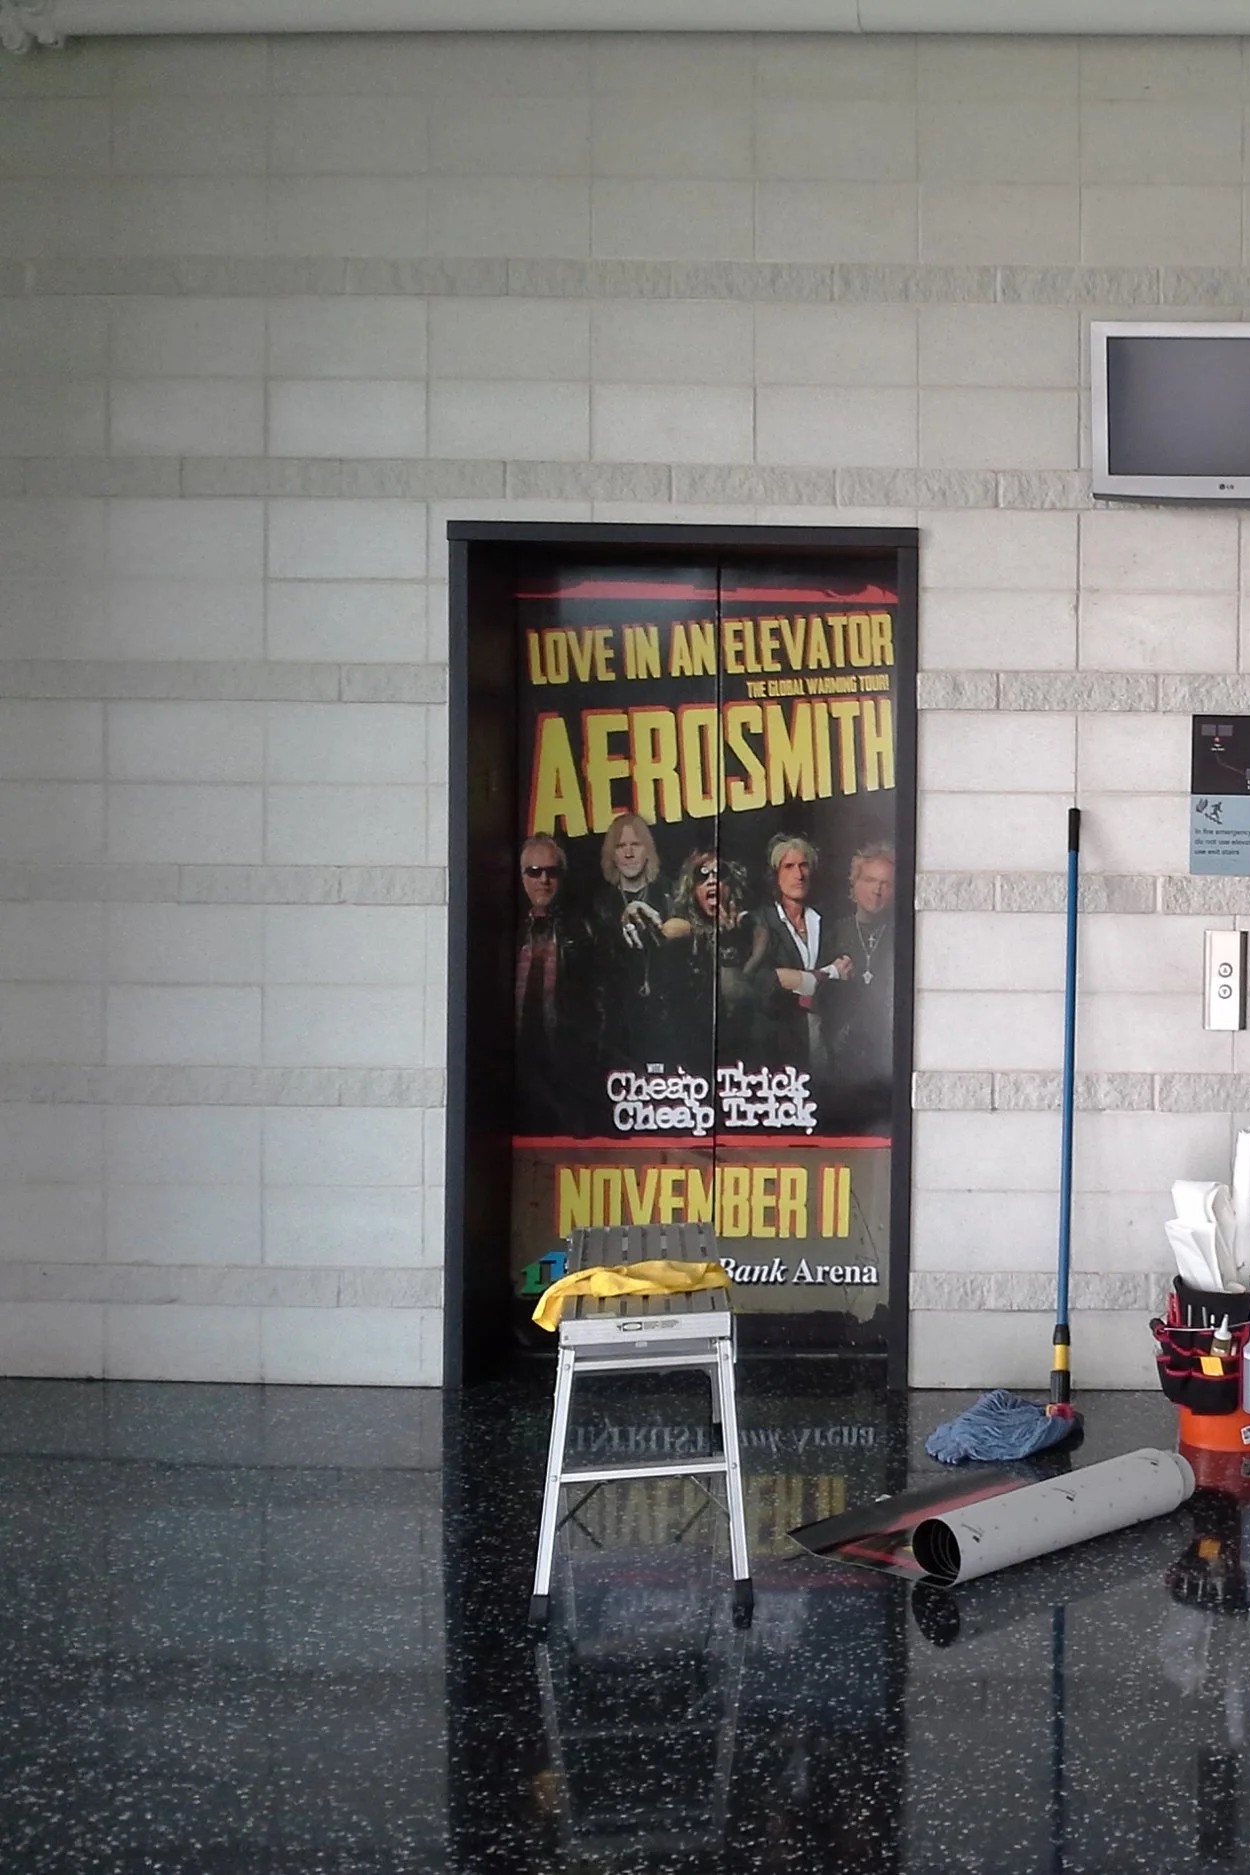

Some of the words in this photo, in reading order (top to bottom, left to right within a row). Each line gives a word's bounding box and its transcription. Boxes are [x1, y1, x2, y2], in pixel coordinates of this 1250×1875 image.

[527, 628, 616, 685] LOVE
[622, 623, 661, 679] IN
[669, 620, 717, 677] AN
[722, 612, 894, 674] ELEVATOR
[747, 681, 767, 698] THE
[768, 679, 805, 697] GLOBAL
[805, 676, 857, 694] WARMING
[530, 697, 896, 837] AEROSMITH
[607, 1065, 710, 1106] Cheap
[717, 1060, 811, 1098] Trick
[614, 1101, 715, 1135] Cheap
[723, 1098, 817, 1134] Trick
[556, 1164, 808, 1238] NOVEMBER
[720, 1257, 787, 1283] Bank
[792, 1258, 878, 1284] Arena
